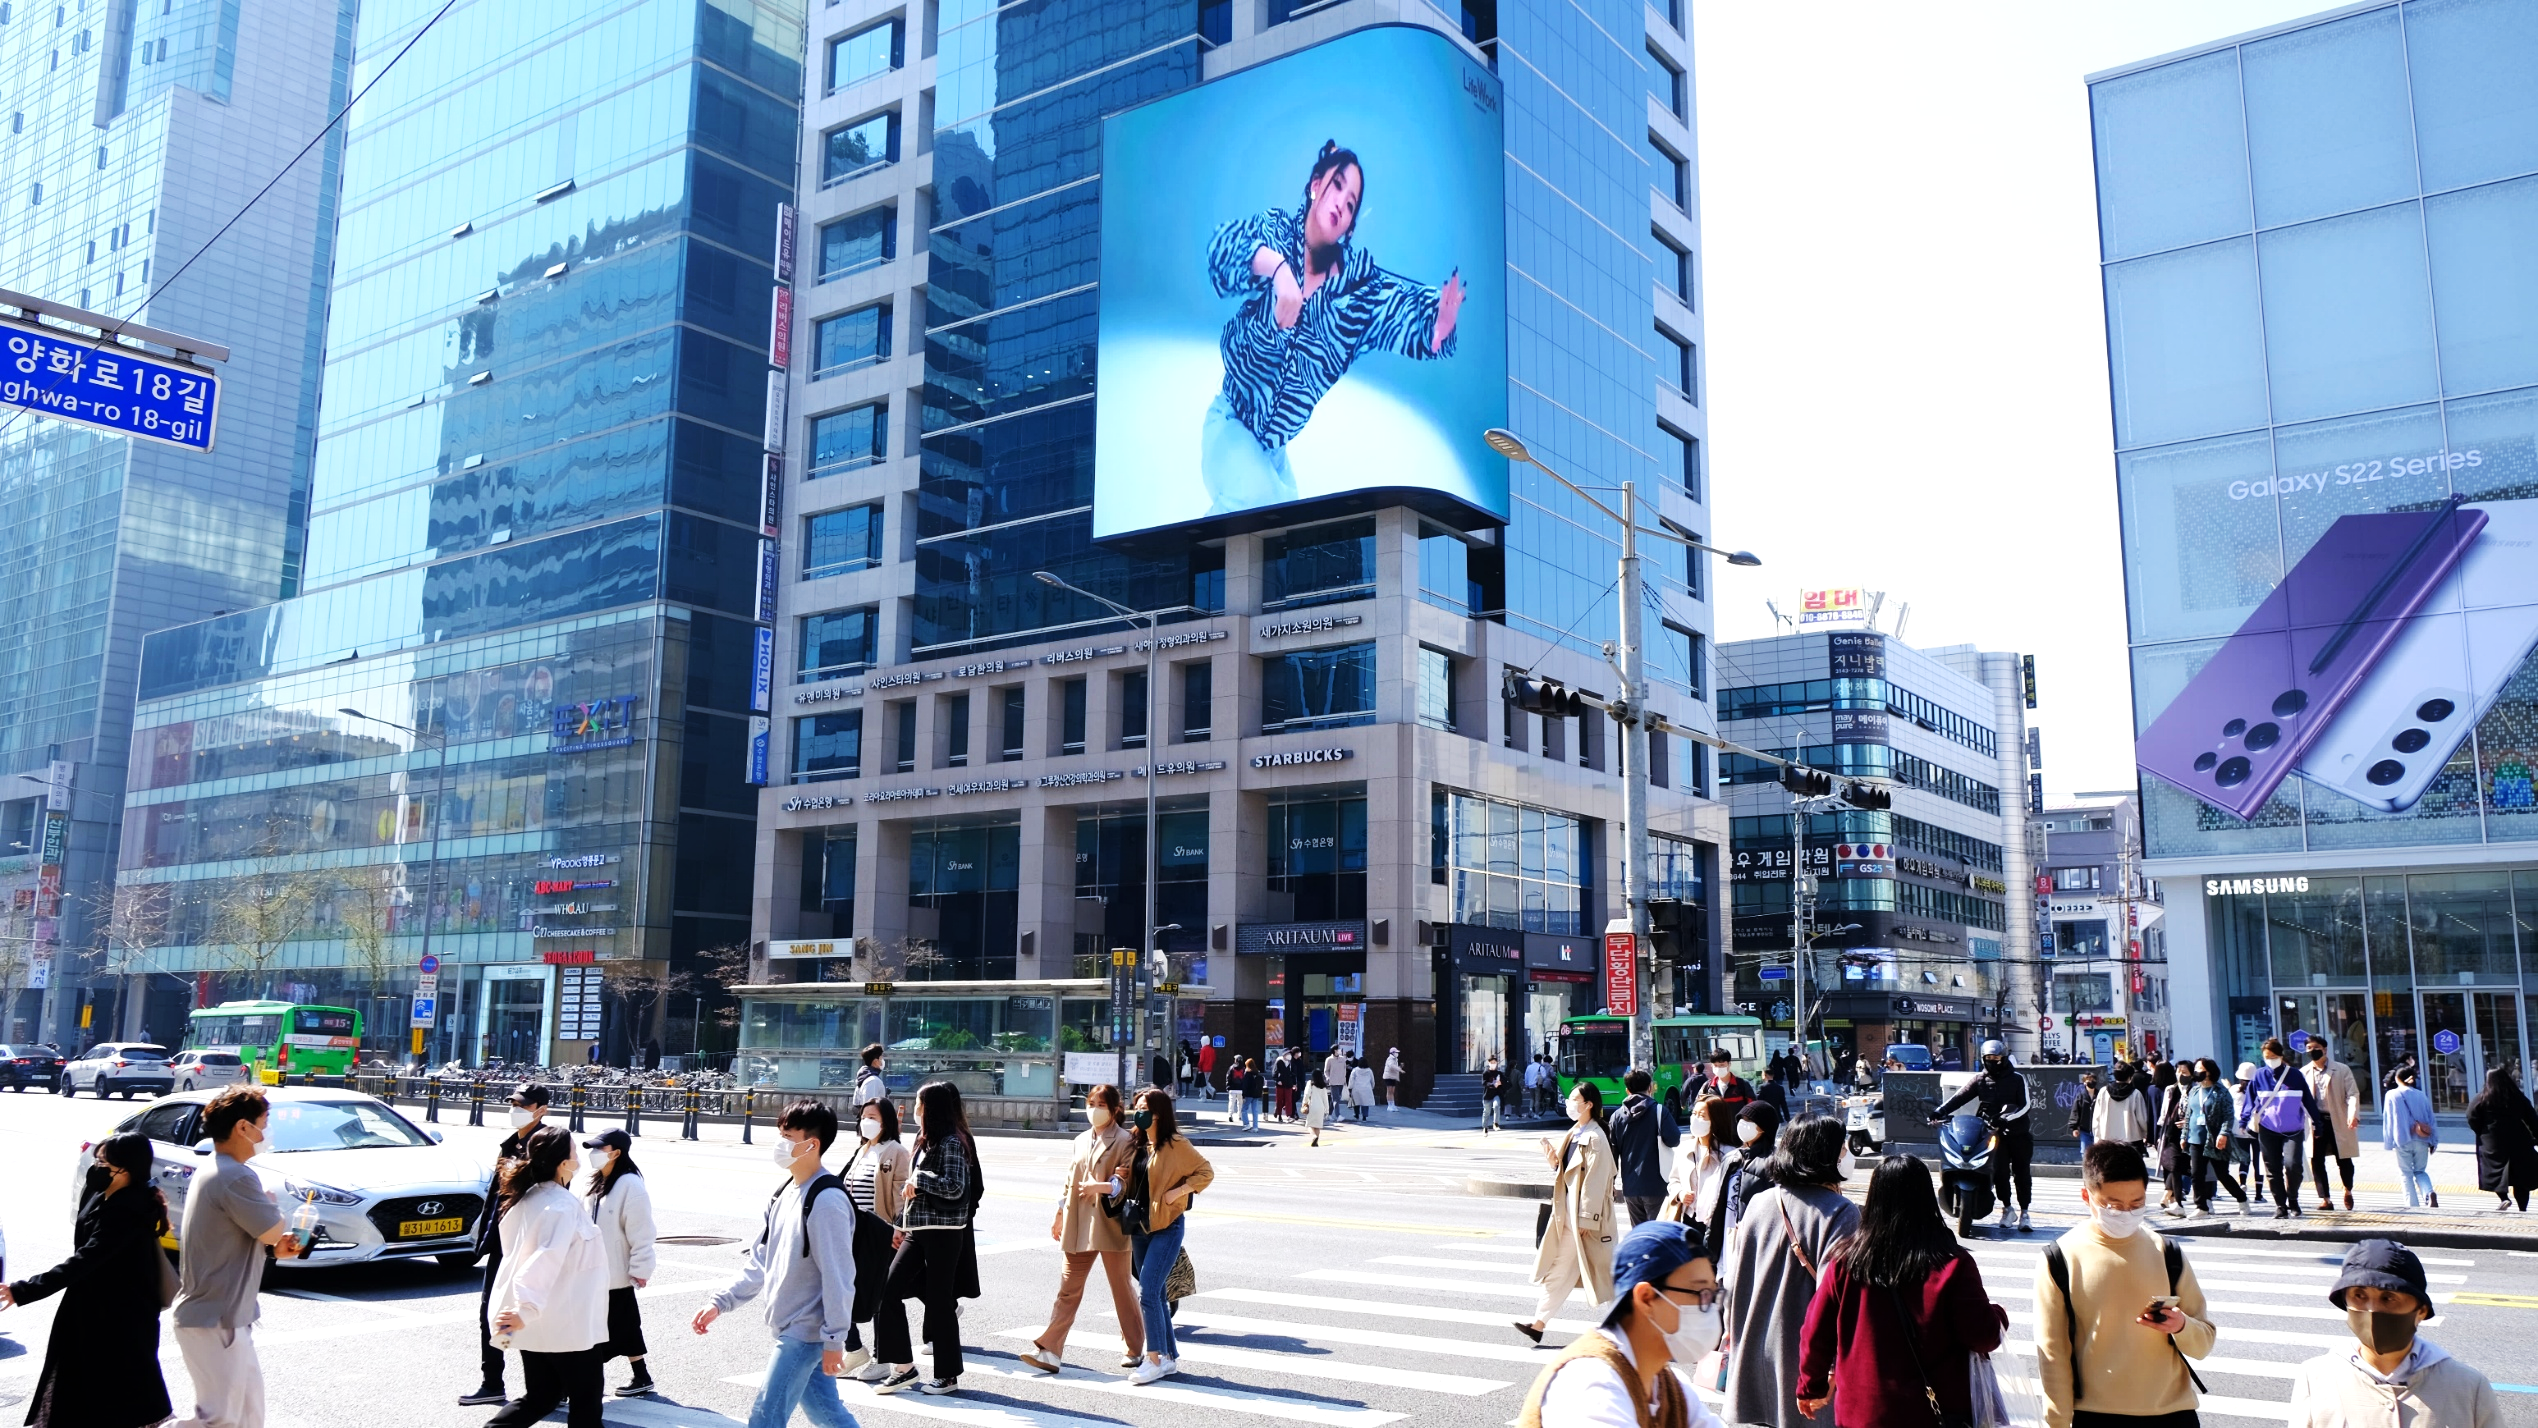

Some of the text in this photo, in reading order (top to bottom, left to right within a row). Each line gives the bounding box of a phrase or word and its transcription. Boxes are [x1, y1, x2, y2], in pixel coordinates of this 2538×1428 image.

[777, 302, 788, 352] 리버스의원
[8, 336, 208, 416] 양화로18길
[131, 406, 203, 442] 18-gil
[2228, 448, 2483, 501] Galaxy S22 Series
[1803, 589, 1858, 610] 임대
[1260, 616, 1334, 639] 세가지소원의원
[1833, 637, 1863, 646] Genie
[1047, 647, 1094, 665] 리버스의원
[1834, 654, 1885, 674] 지니발레
[958, 660, 1005, 677] 로담한의원
[871, 671, 922, 690] 샤인스타의원
[798, 687, 842, 704] 유앤미의원
[553, 695, 638, 737] EXIT
[1835, 714, 1853, 723] may
[1835, 722, 1854, 731] pure
[1255, 747, 1344, 768] STARBUCKS
[1304, 836, 1334, 849] 수협은행
[1186, 848, 1204, 856] BANK
[1757, 850, 1791, 867] 게임
[1753, 869, 1787, 879] 취업전문
[1859, 863, 1883, 873] GS25
[2206, 876, 2309, 896] SAMSUNG
[1264, 929, 1351, 945] ARITAUM LIVE
[789, 943, 833, 955] SANG JIN
[1468, 941, 1510, 958] ARITAUM
[1561, 944, 1571, 961] kt
[1608, 936, 1633, 1014] 무단횡단금지
[1740, 1002, 1757, 1011] CE
[1937, 1003, 1954, 1014] PLACE
[2044, 1039, 2061, 1047] FFEE
[2440, 1034, 2452, 1043] 24
[434, 1219, 459, 1231] 1613
